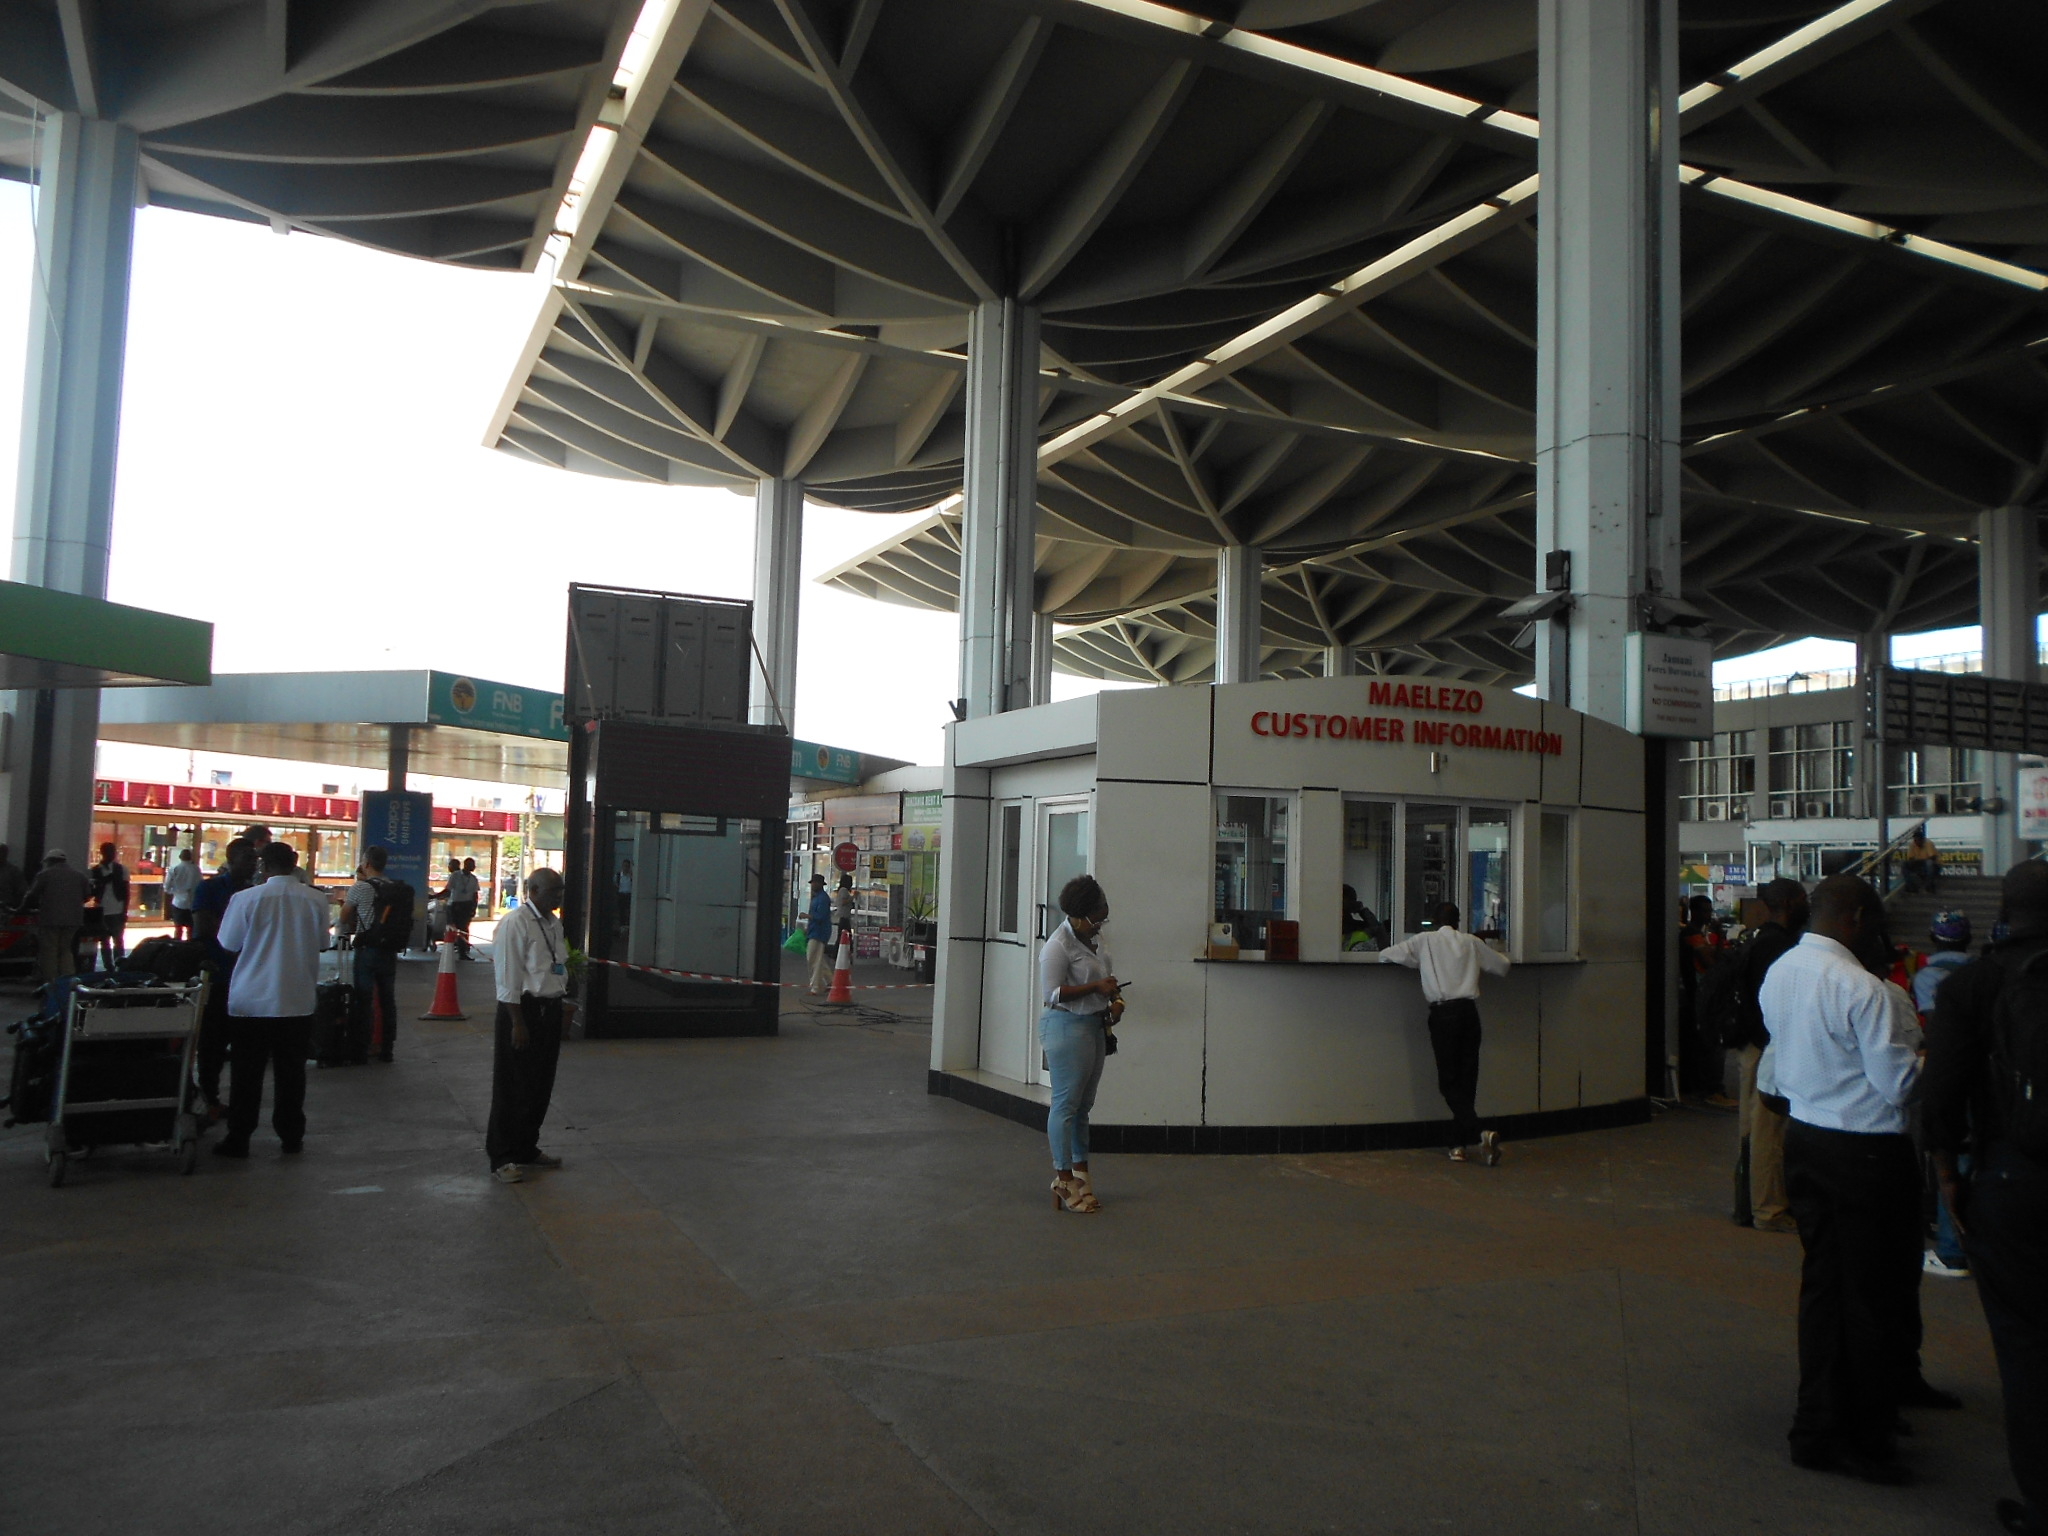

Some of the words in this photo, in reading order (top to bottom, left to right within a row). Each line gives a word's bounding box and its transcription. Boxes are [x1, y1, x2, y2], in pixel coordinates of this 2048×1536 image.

[492, 689, 523, 713] FNB
[1368, 681, 1484, 714] MAELEZO
[1250, 710, 1406, 743] CUSTOMER
[1413, 719, 1563, 756] INFORMATION
[384, 800, 400, 844] Galaxy
[400, 800, 411, 845] SAMSUNG
[1724, 874, 1746, 882] BUREA
